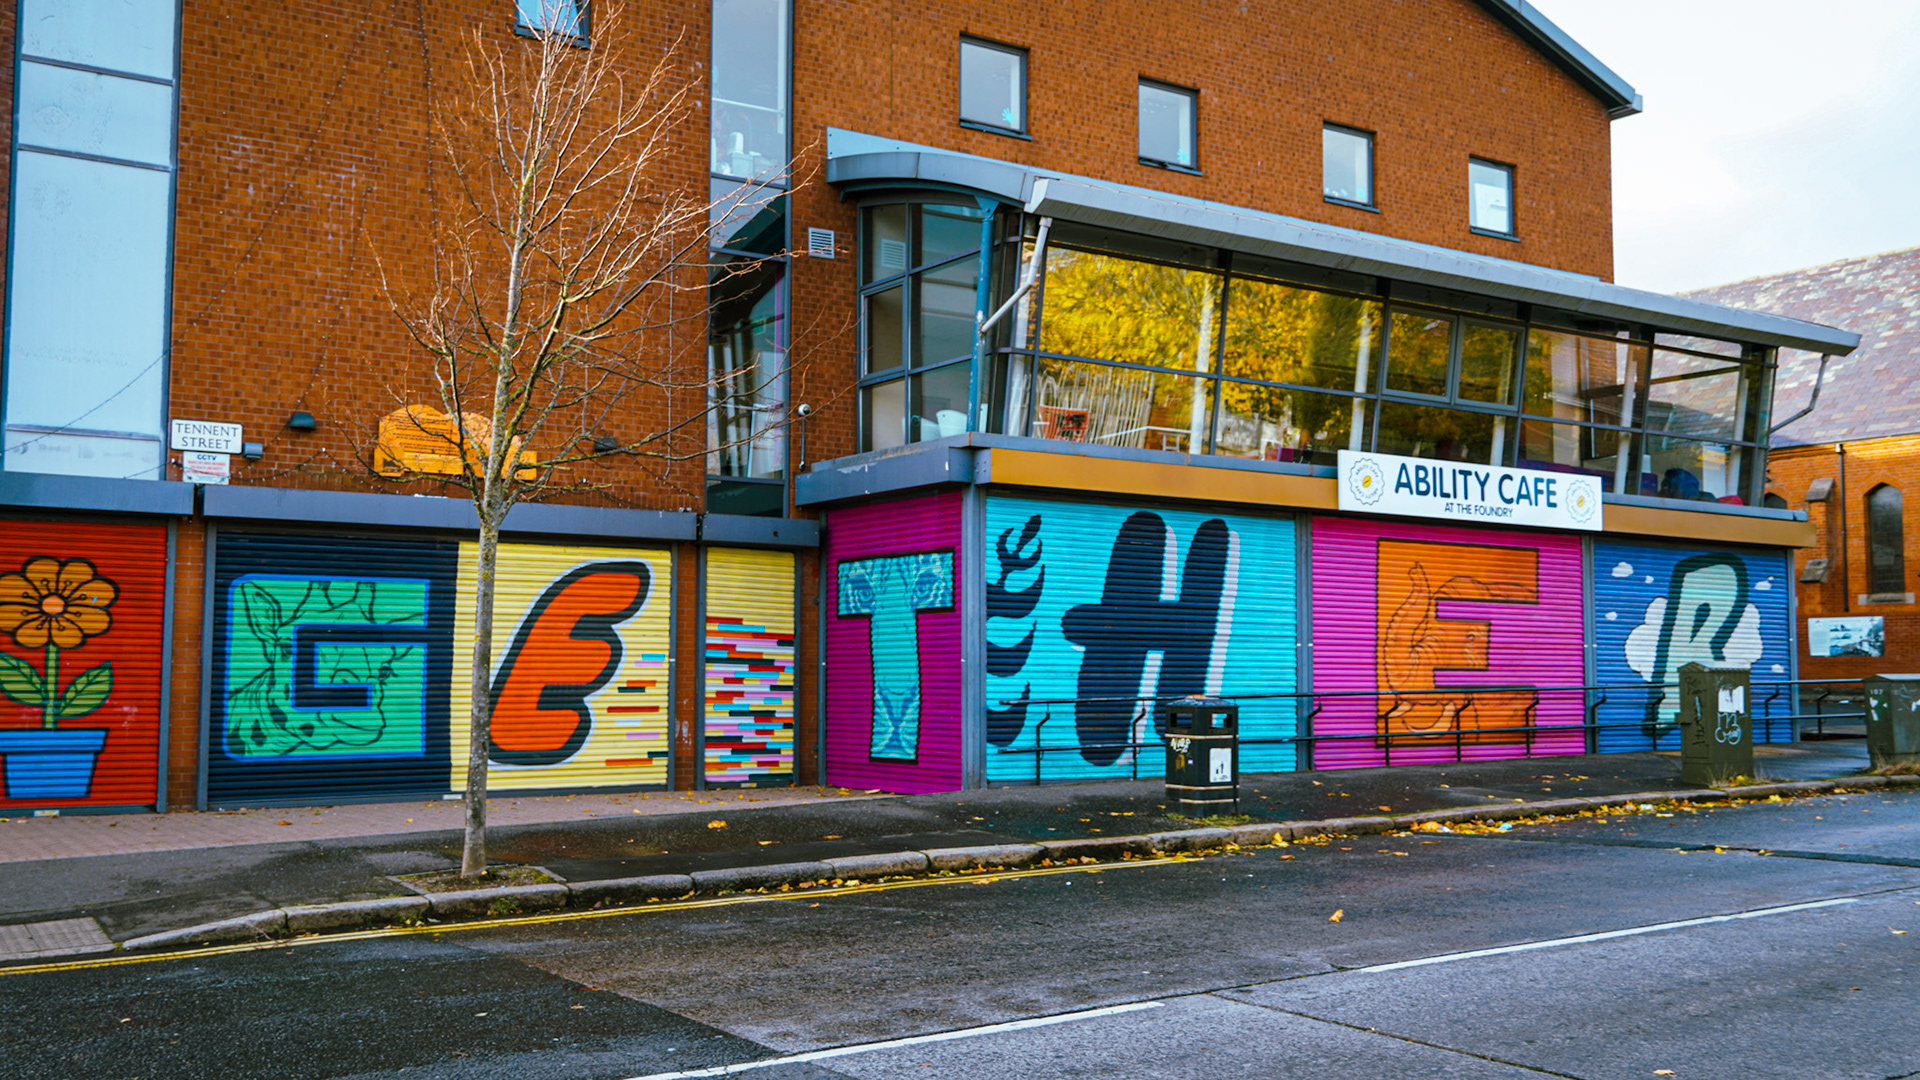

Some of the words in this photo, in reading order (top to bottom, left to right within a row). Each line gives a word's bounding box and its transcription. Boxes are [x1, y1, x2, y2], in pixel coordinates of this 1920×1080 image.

[175, 422, 240, 437] TENNENT
[181, 436, 232, 450] STREET
[196, 453, 217, 461] CCTV
[1394, 462, 1490, 502] ABILITY
[1498, 473, 1558, 509] CAFE
[1444, 502, 1455, 513] AT
[1456, 503, 1472, 515] THE
[1474, 504, 1514, 518] FOUNDRY
